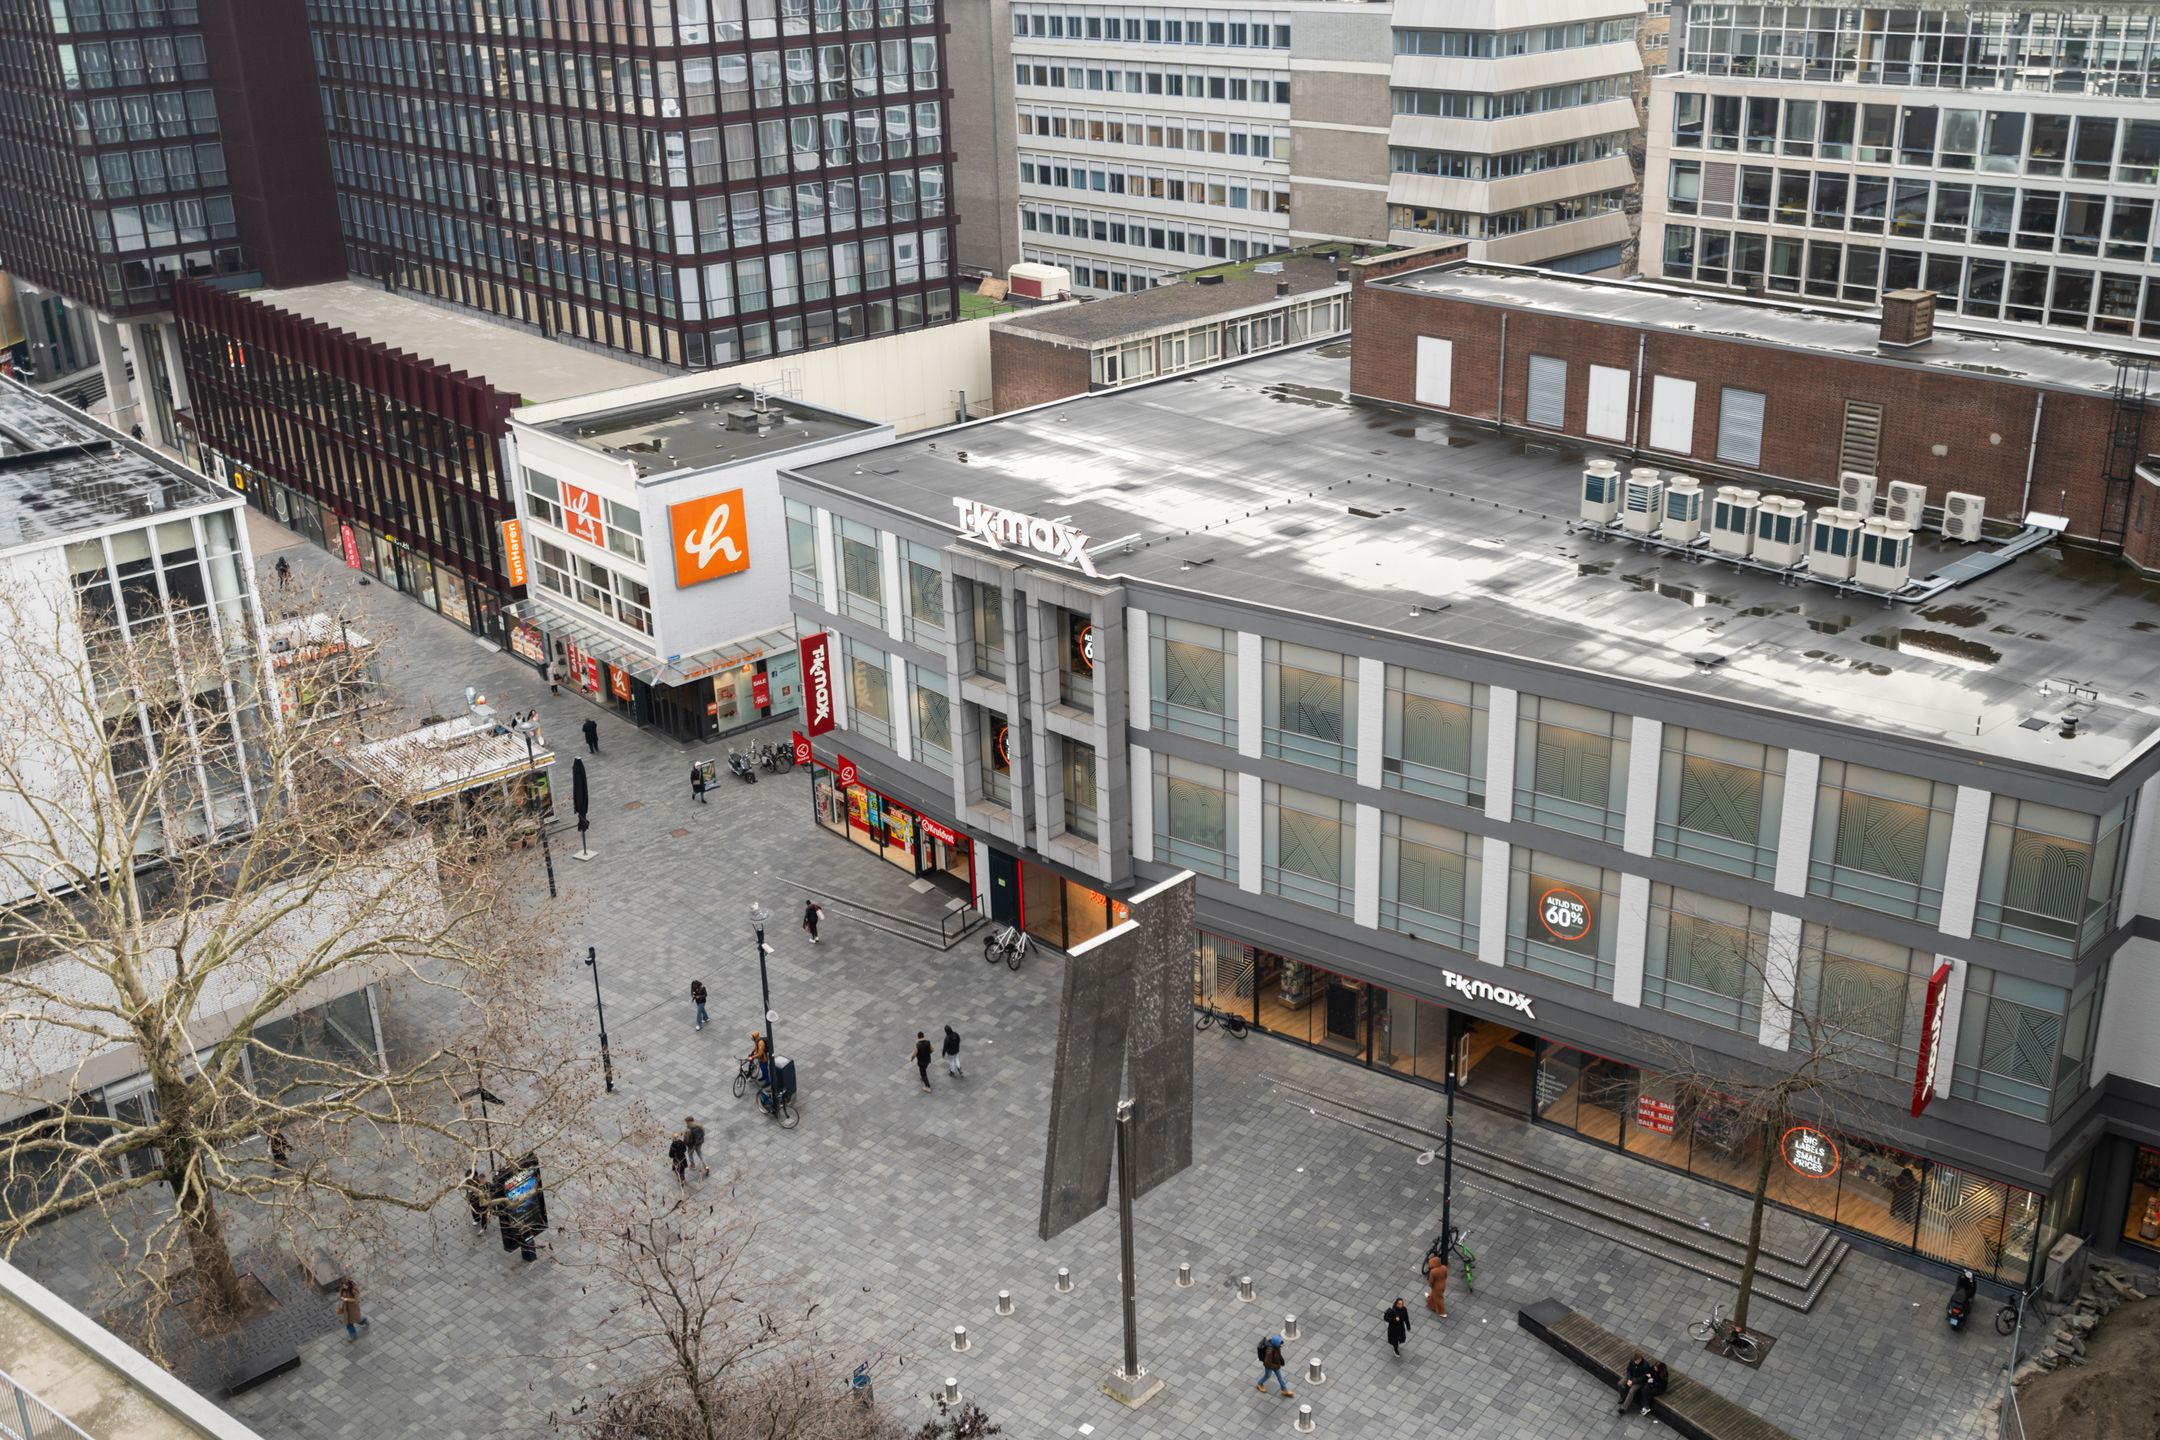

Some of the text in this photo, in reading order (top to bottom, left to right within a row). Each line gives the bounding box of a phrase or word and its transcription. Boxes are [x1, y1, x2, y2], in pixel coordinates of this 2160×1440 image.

[508, 522, 524, 583] vanHaren
[753, 678, 766, 687] SALE
[929, 822, 955, 845] Kruidvat
[1547, 896, 1584, 913] ALTIJD TOT
[1546, 906, 1583, 927] 60%
[1640, 1097, 1675, 1110] SALE SALE
[1639, 1109, 1674, 1121] SALE SALE
[1638, 1119, 1673, 1131] SALE SALE
[1795, 1140, 1825, 1156] LABELS
[1803, 1135, 1818, 1146] BIG
[1793, 1158, 1823, 1173] PRICES
[1796, 1150, 1821, 1166] SMALL
